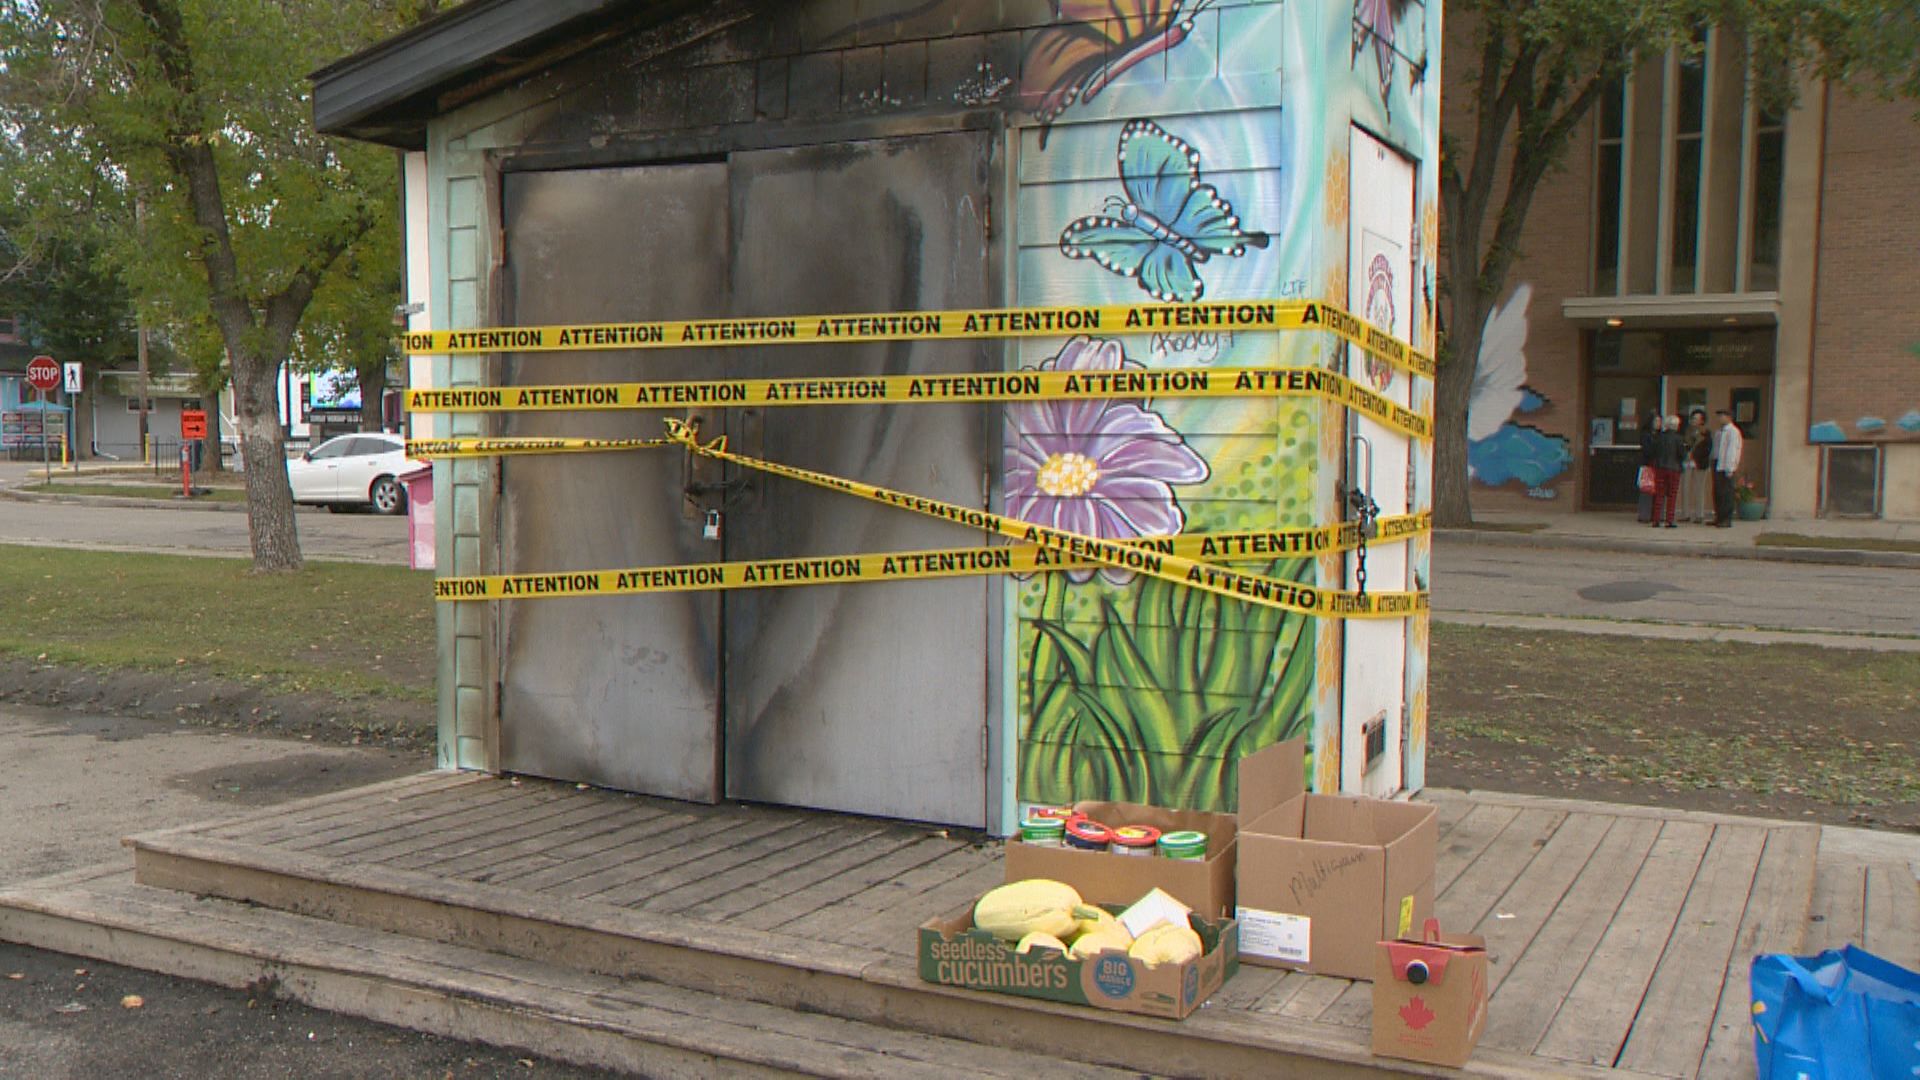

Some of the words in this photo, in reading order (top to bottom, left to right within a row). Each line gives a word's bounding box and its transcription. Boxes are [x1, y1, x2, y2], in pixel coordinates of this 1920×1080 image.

[448, 331, 542, 349] ATTENTION
[559, 326, 664, 346] ATTENTION
[682, 321, 796, 342] ATTENTION
[816, 315, 941, 337] ATTENTION
[963, 309, 1100, 332] ATTENTION
[1125, 304, 1275, 328] ATTENTION
[1301, 304, 1360, 341] ATTENTION
[1367, 328, 1404, 361] ATTENTION
[29, 367, 58, 381] STOP
[412, 390, 501, 408] ATTENTION
[518, 386, 619, 406] ATTENTION
[636, 383, 746, 403] ATTENTION
[766, 380, 886, 400] ATTENTION
[908, 375, 1040, 398] ATTENTION
[1064, 372, 1208, 394] ATTENTION
[1234, 370, 1342, 398] ATTENTION
[1350, 384, 1388, 417] ATTENTION
[502, 574, 599, 594] ATTENTION
[616, 567, 724, 589] ATTENTION
[743, 558, 861, 583] ATTENTION
[882, 549, 1011, 574] ATTENTION
[1200, 528, 1328, 556] ATTENTION
[874, 490, 1000, 533] ATTENTION
[1024, 526, 1162, 573] ATTENTION
[1186, 565, 1323, 610] ATTENTION
[1377, 594, 1411, 612] ATTENTION
[930, 937, 1006, 962] seedless
[1104, 961, 1128, 976] BIG
[938, 955, 1068, 989] cucumbers
